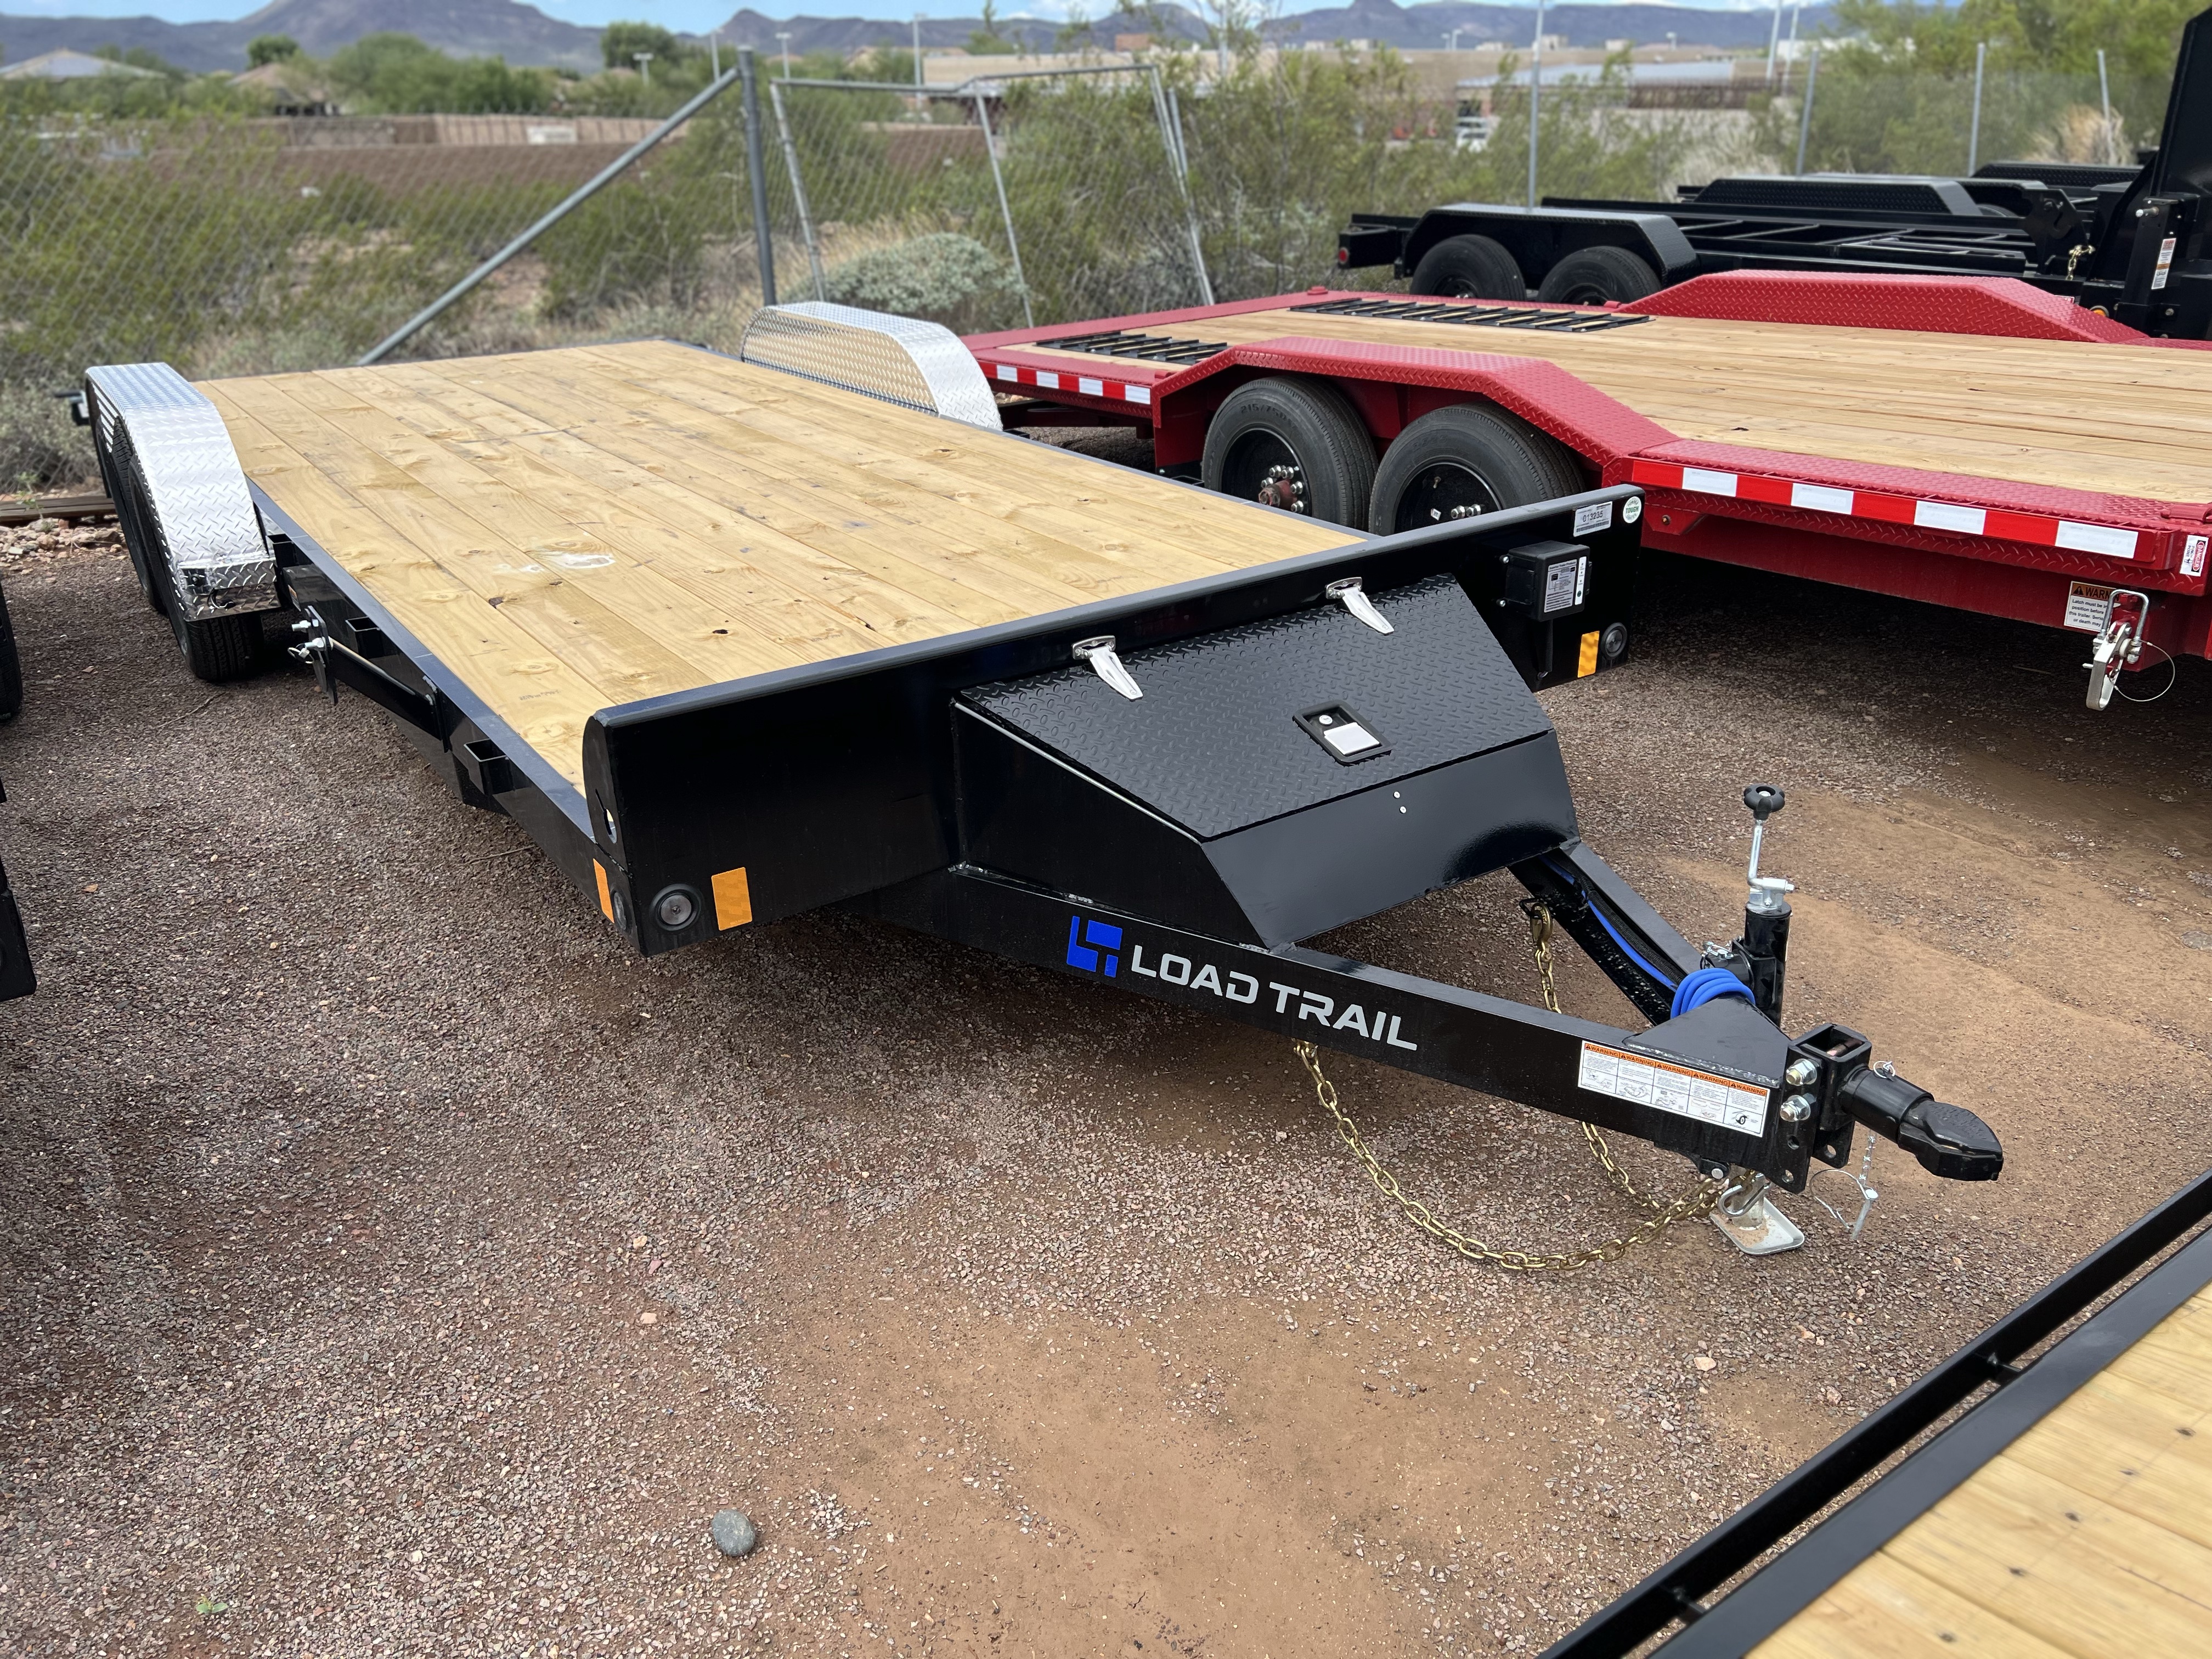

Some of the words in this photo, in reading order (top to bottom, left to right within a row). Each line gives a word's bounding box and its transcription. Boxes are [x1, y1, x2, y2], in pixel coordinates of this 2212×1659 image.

[1583, 510, 1604, 522] 013235
[2193, 544, 2203, 568] DANGER
[1131, 945, 1259, 1003] LOAD
[1269, 981, 1417, 1051] TRAIL
[1591, 1045, 1619, 1057] WARNING
[1626, 1054, 1654, 1066] WARNING
[1662, 1064, 1691, 1076] WARNING
[1699, 1074, 1728, 1086] WARNING
[1736, 1085, 1767, 1096] WARNING
